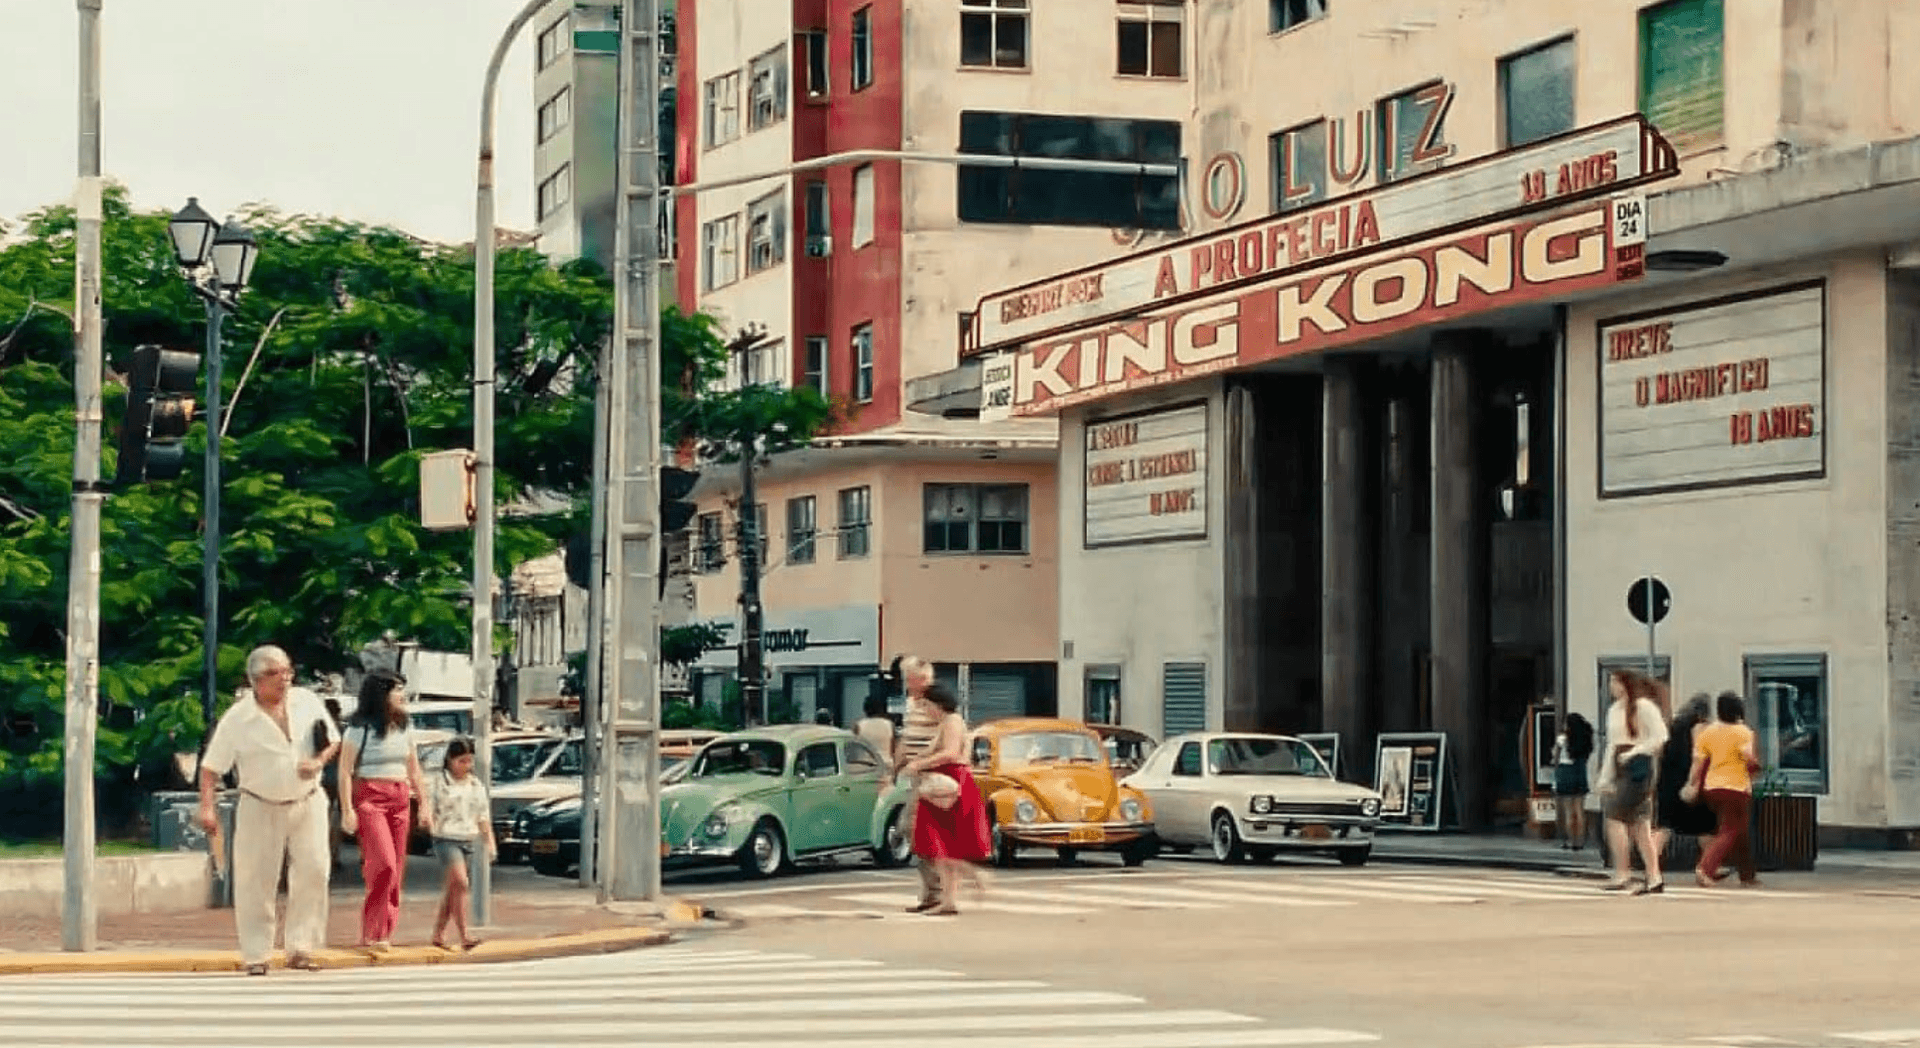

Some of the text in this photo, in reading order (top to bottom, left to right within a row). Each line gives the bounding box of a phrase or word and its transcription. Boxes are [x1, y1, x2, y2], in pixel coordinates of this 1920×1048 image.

[1284, 82, 1456, 200] LUIZ
[1557, 150, 1617, 195] ANOS
[1617, 201, 1642, 220] DIA
[1620, 219, 1638, 237] 24
[1154, 253, 1178, 299] A
[1190, 199, 1381, 292] PROFECIA
[1015, 206, 1607, 407] KING KONG
[1757, 403, 1815, 443] ANOS
